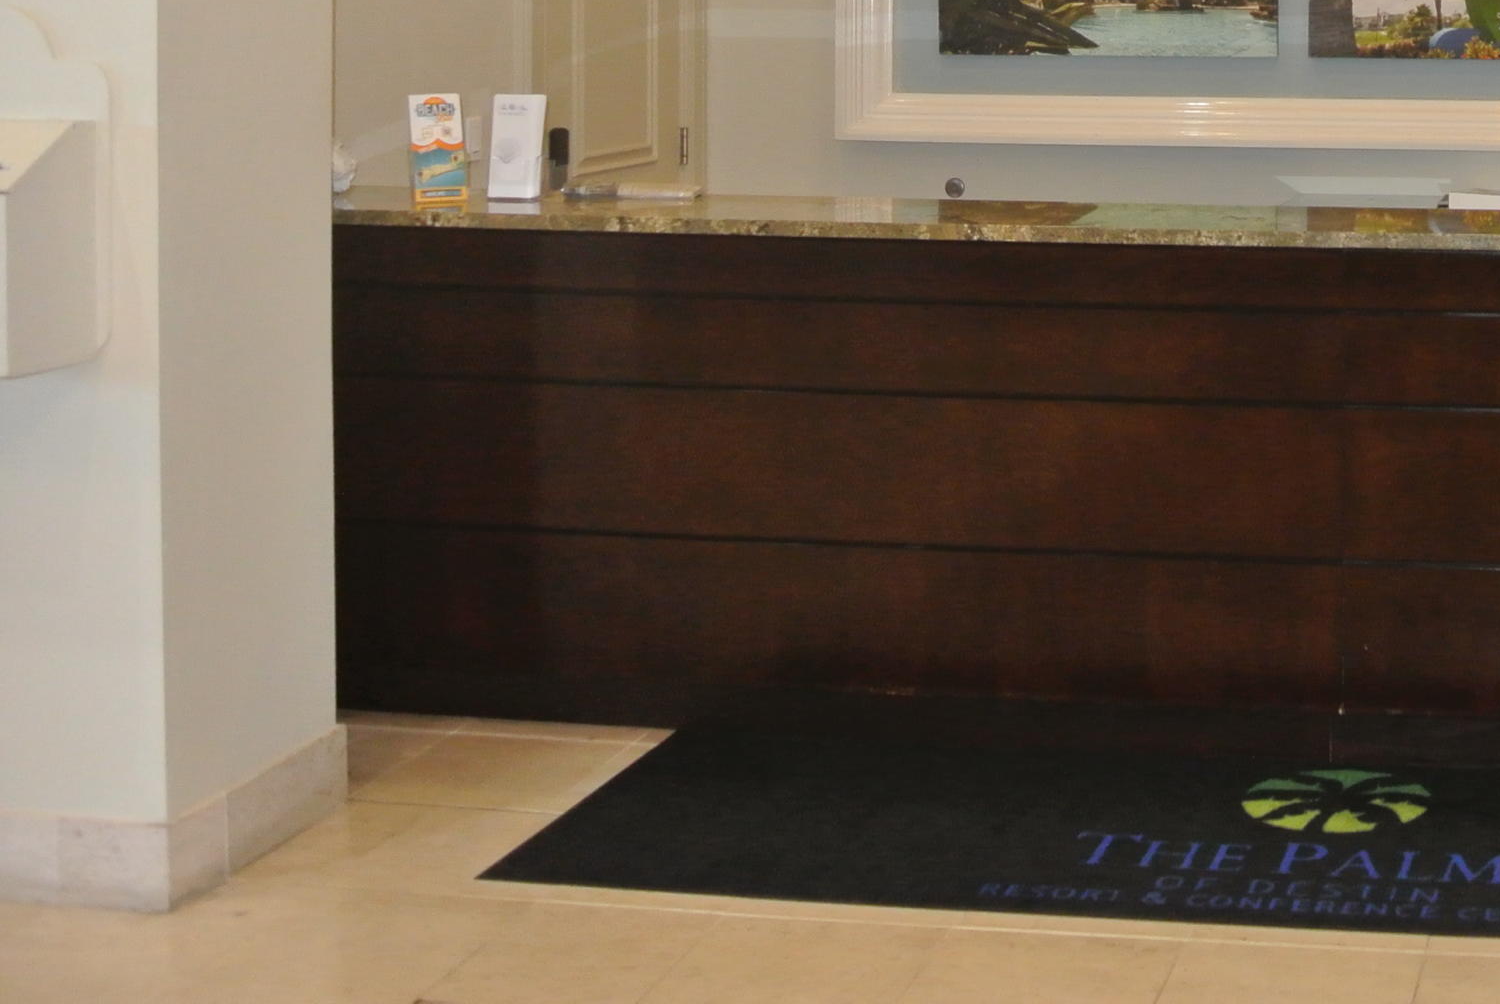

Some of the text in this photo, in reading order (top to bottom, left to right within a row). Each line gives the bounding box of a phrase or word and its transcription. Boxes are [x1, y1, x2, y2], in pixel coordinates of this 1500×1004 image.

[1077, 831, 1251, 872] THE
[978, 882, 1120, 902] RESORT
[1142, 891, 1167, 905] &
[1187, 895, 1442, 920] CONFERENCE
[1154, 875, 1441, 904] OF DESTIN
